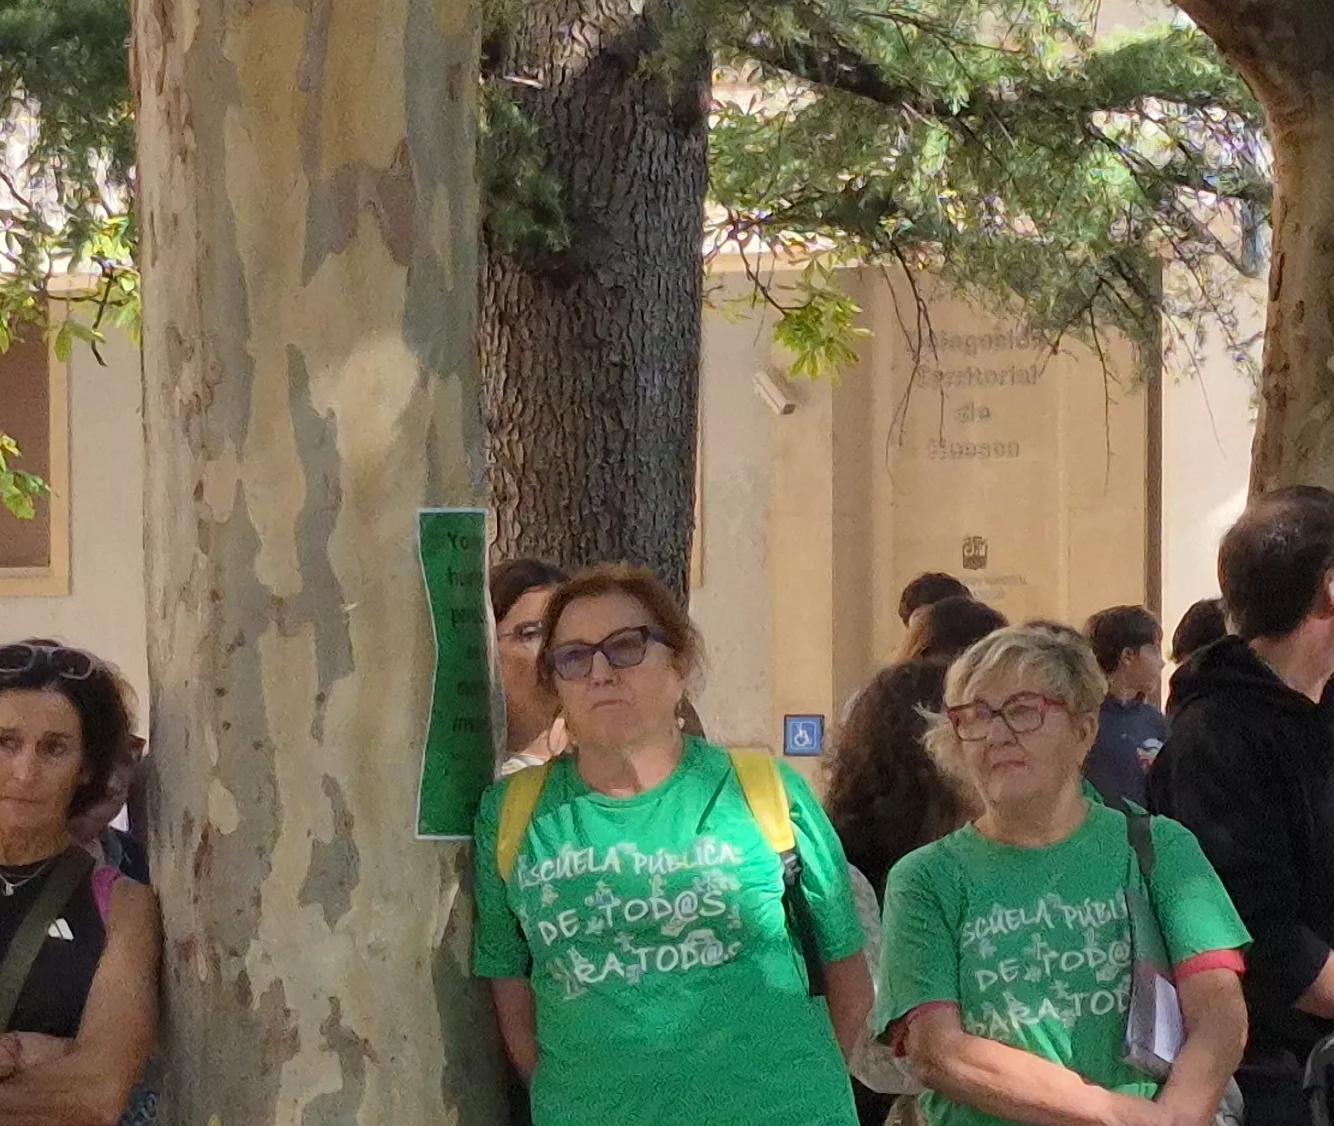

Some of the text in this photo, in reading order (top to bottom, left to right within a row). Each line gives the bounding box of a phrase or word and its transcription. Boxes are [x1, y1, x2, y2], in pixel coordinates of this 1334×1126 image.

[537, 889, 727, 947] DE TOD@S
[962, 898, 1056, 949] SCUELA
[974, 940, 1131, 993] DE TOD@
[1066, 988, 1132, 1017] TOD
